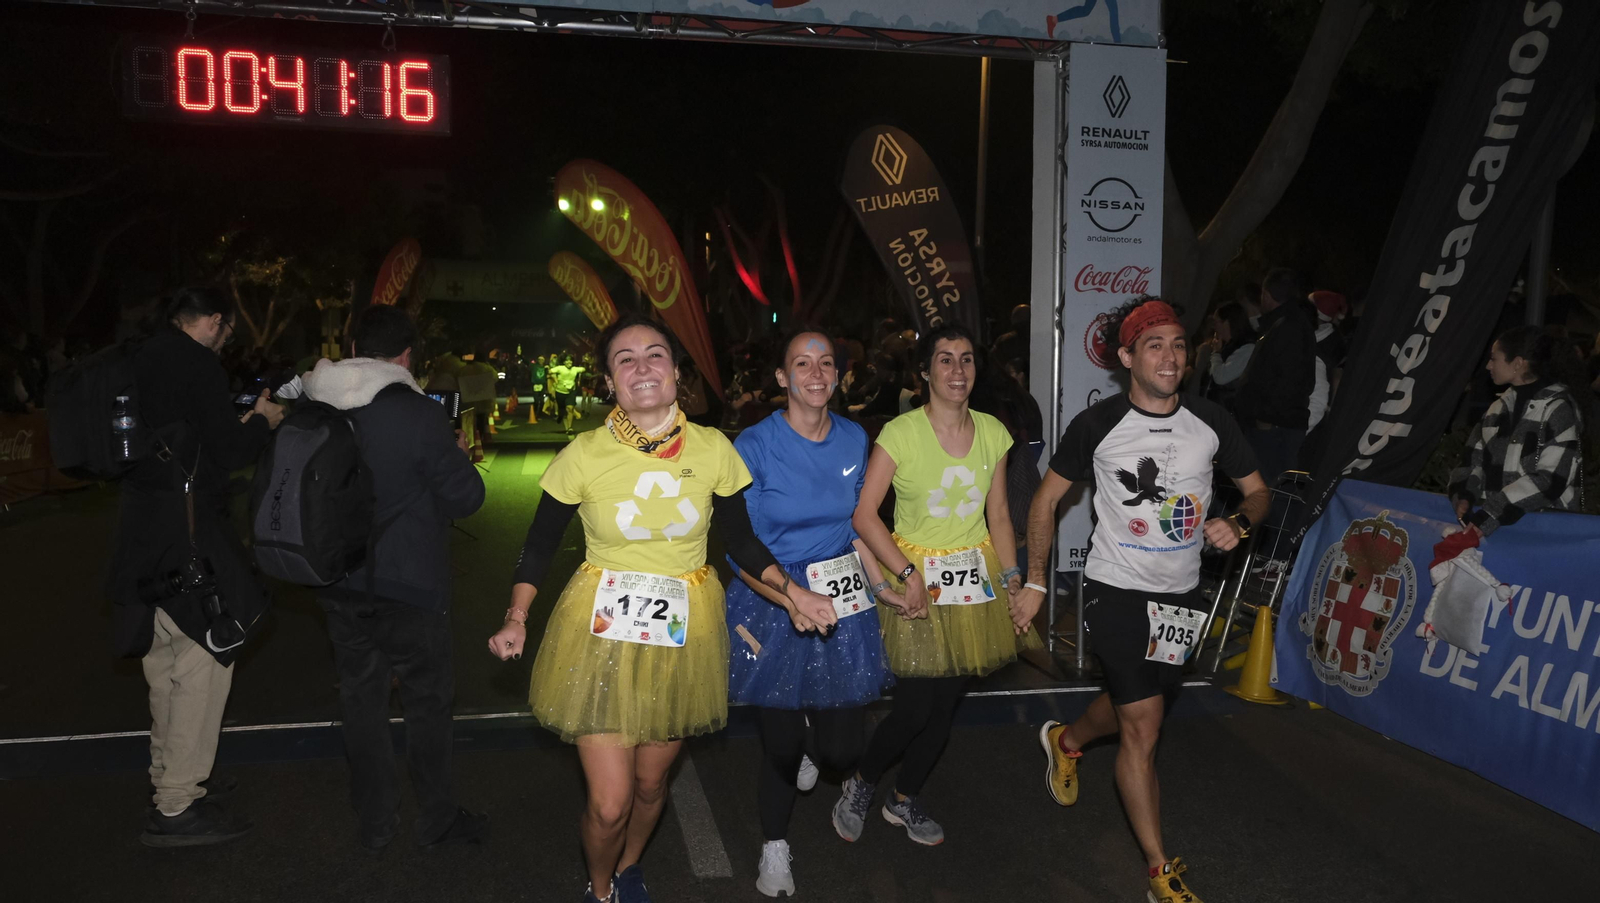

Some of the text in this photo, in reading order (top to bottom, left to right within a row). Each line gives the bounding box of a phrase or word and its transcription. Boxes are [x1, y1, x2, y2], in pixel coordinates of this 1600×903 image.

[177, 47, 435, 122] 00:41:16
[1081, 126, 1150, 141] RENAULT
[1081, 139, 1149, 151] SYRSA AUTOMOCION
[1081, 199, 1145, 211] NISSAN
[1087, 234, 1142, 245] andalmotor.es
[1074, 263, 1155, 295] Coca-Cola
[615, 410, 649, 445] entre
[1070, 548, 1088, 558] RE
[1070, 560, 1085, 568] SYRS
[826, 573, 863, 599] 328
[941, 568, 980, 587] 975
[617, 594, 669, 620] 172
[1479, 584, 1600, 657] YUN
[1157, 623, 1194, 646] 1035
[1419, 639, 1479, 692] DE
